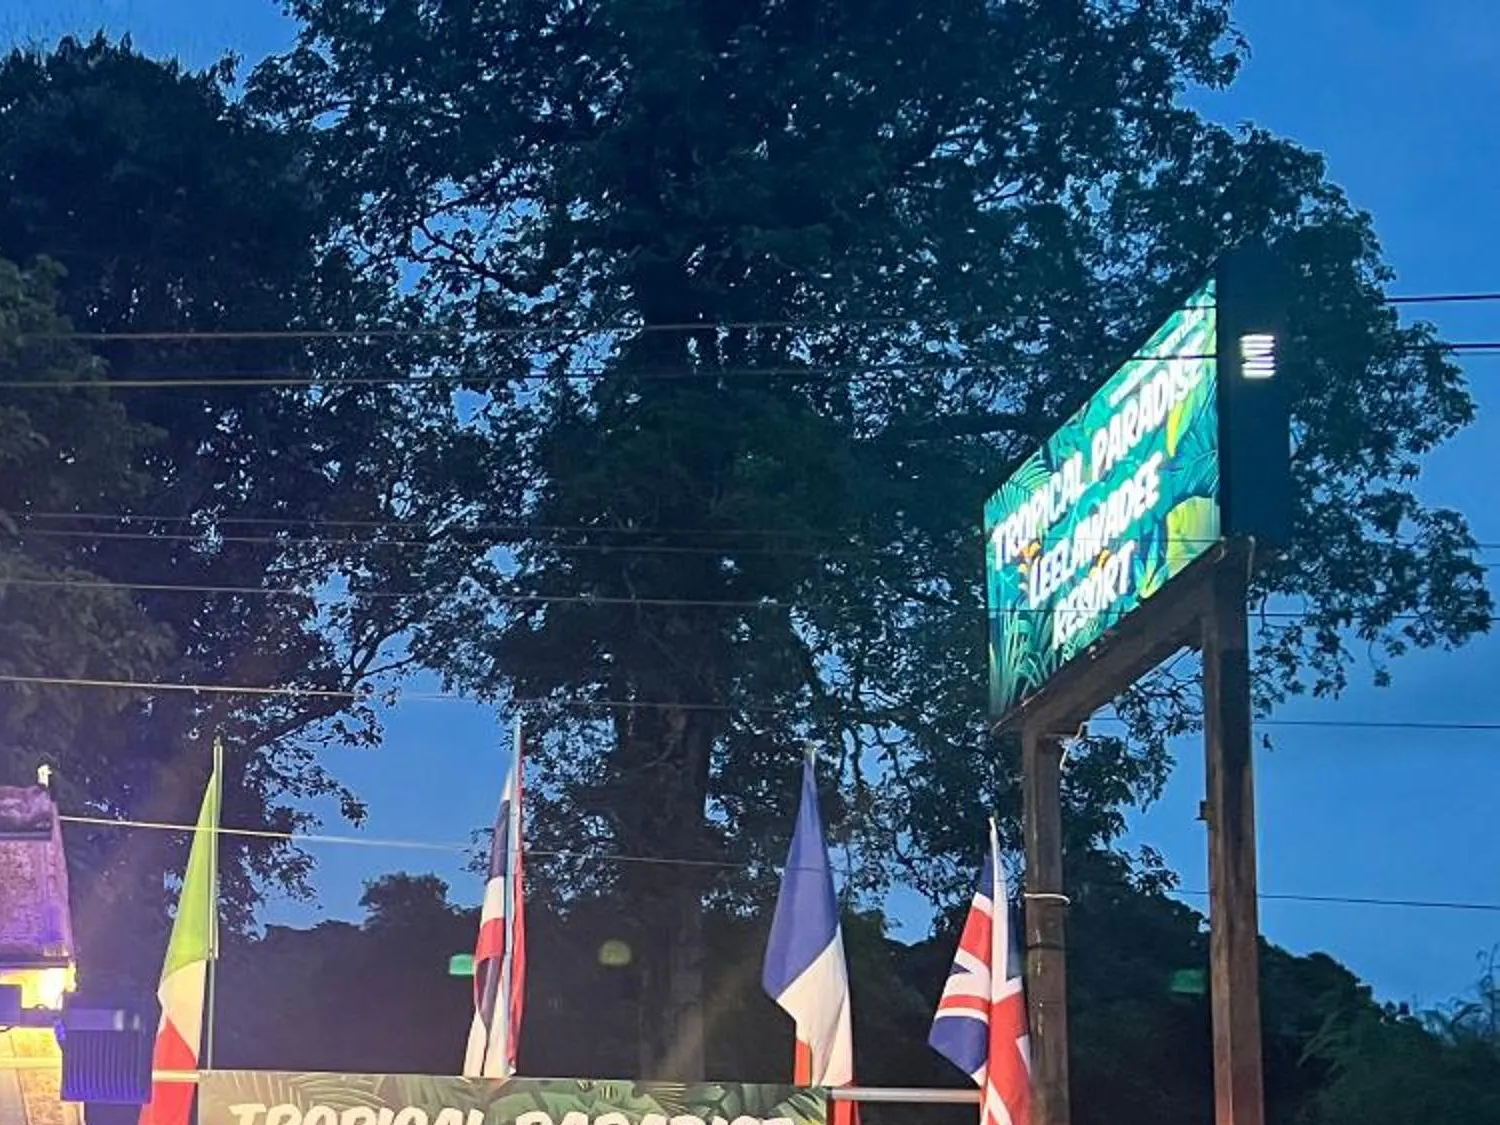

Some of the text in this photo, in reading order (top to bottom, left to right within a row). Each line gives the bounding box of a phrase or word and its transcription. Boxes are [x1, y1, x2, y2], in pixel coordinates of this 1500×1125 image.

[991, 456, 1088, 571] TROPICAL
[1091, 331, 1204, 482] PARADISE
[1028, 451, 1164, 610] LEELAWADEE
[1052, 542, 1135, 650] RESORT
